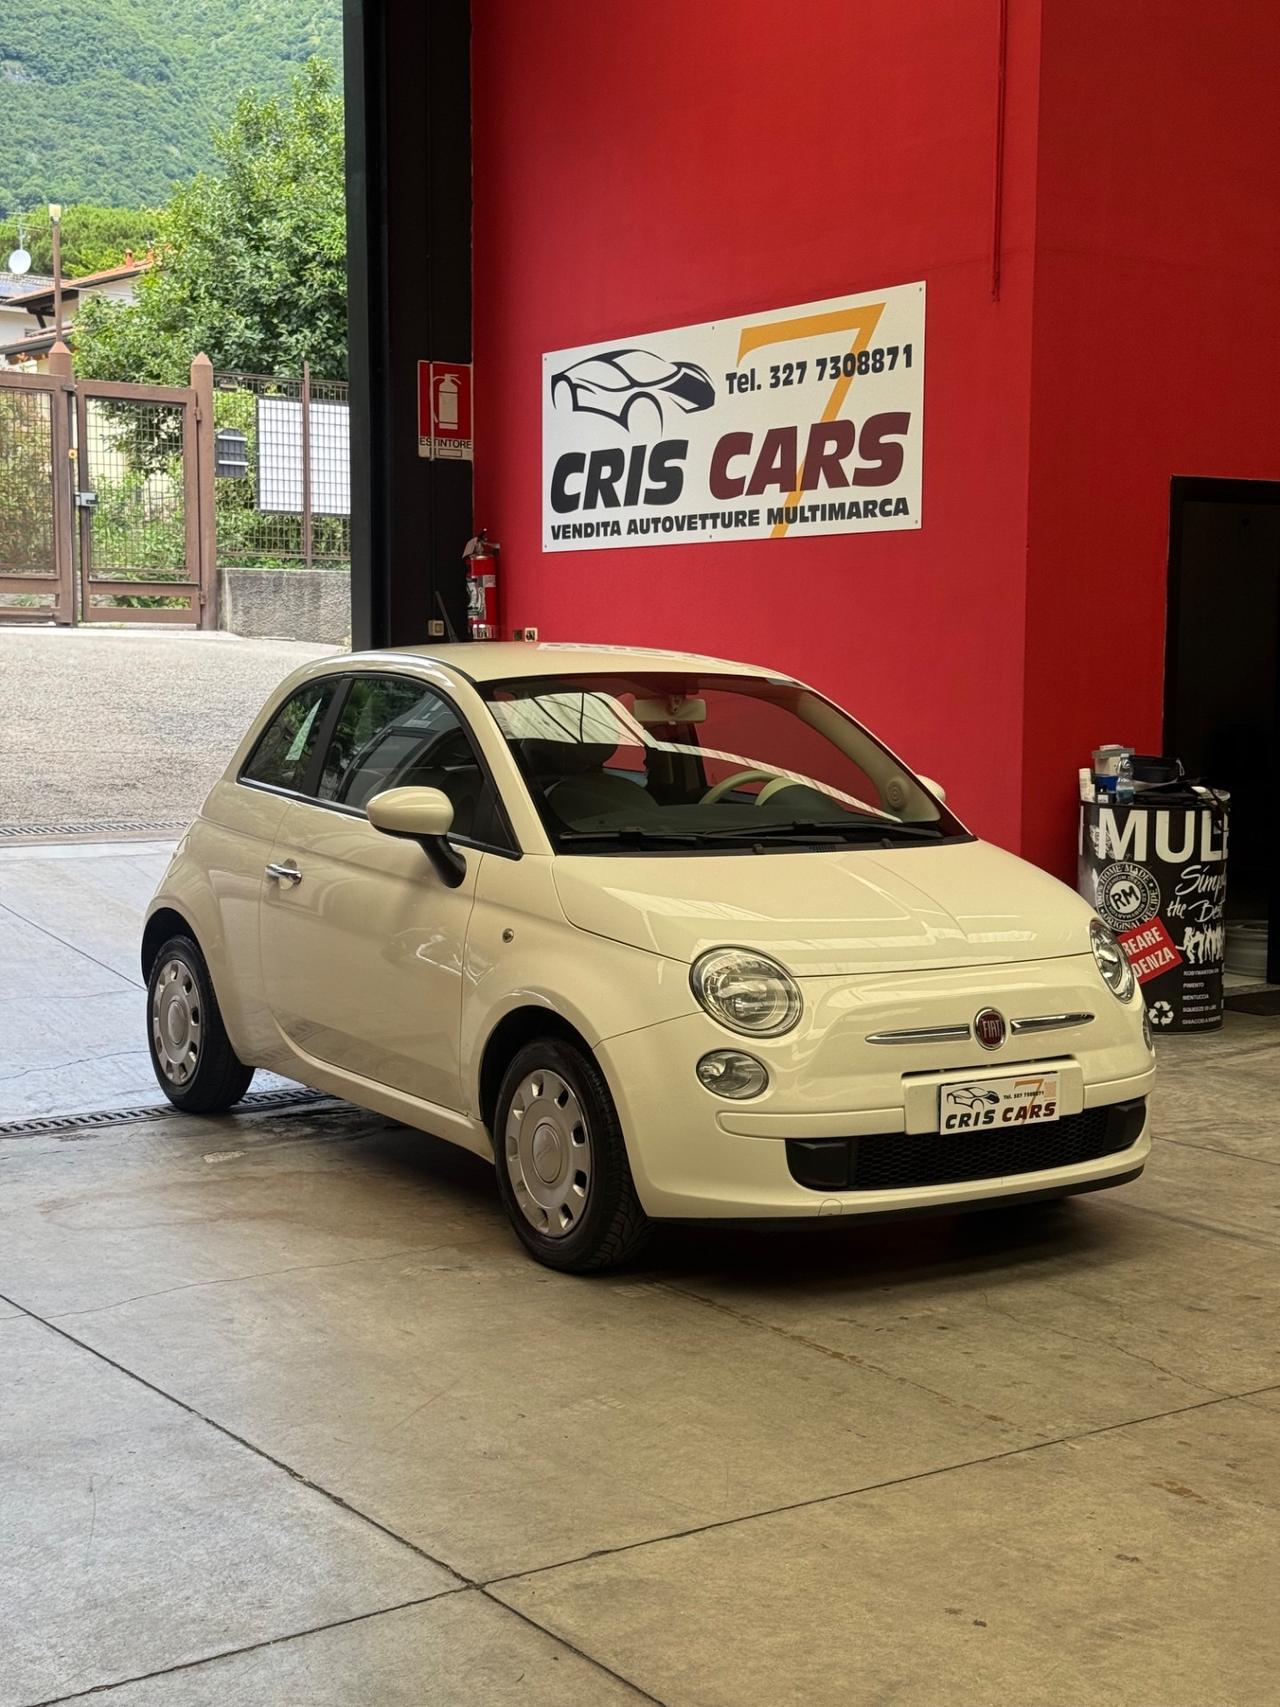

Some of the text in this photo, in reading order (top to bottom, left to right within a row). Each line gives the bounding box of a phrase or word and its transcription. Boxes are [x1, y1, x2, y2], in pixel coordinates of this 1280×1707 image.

[726, 343, 913, 395] Tel. 327 7308871
[551, 412, 912, 514] CRIS CARS
[551, 497, 910, 541] VENDITA AUTOVETTURE MULTIMARCA
[1100, 864, 1122, 884] HOME
[1124, 864, 1151, 885] MADE
[1111, 885, 1139, 910] RM
[1166, 896, 1187, 919] the
[1102, 911, 1141, 930] ORIGINAL
[1131, 947, 1175, 978] DENZA
[982, 1019, 1001, 1039] FIAT
[945, 1102, 1057, 1130] CRIS CARS
